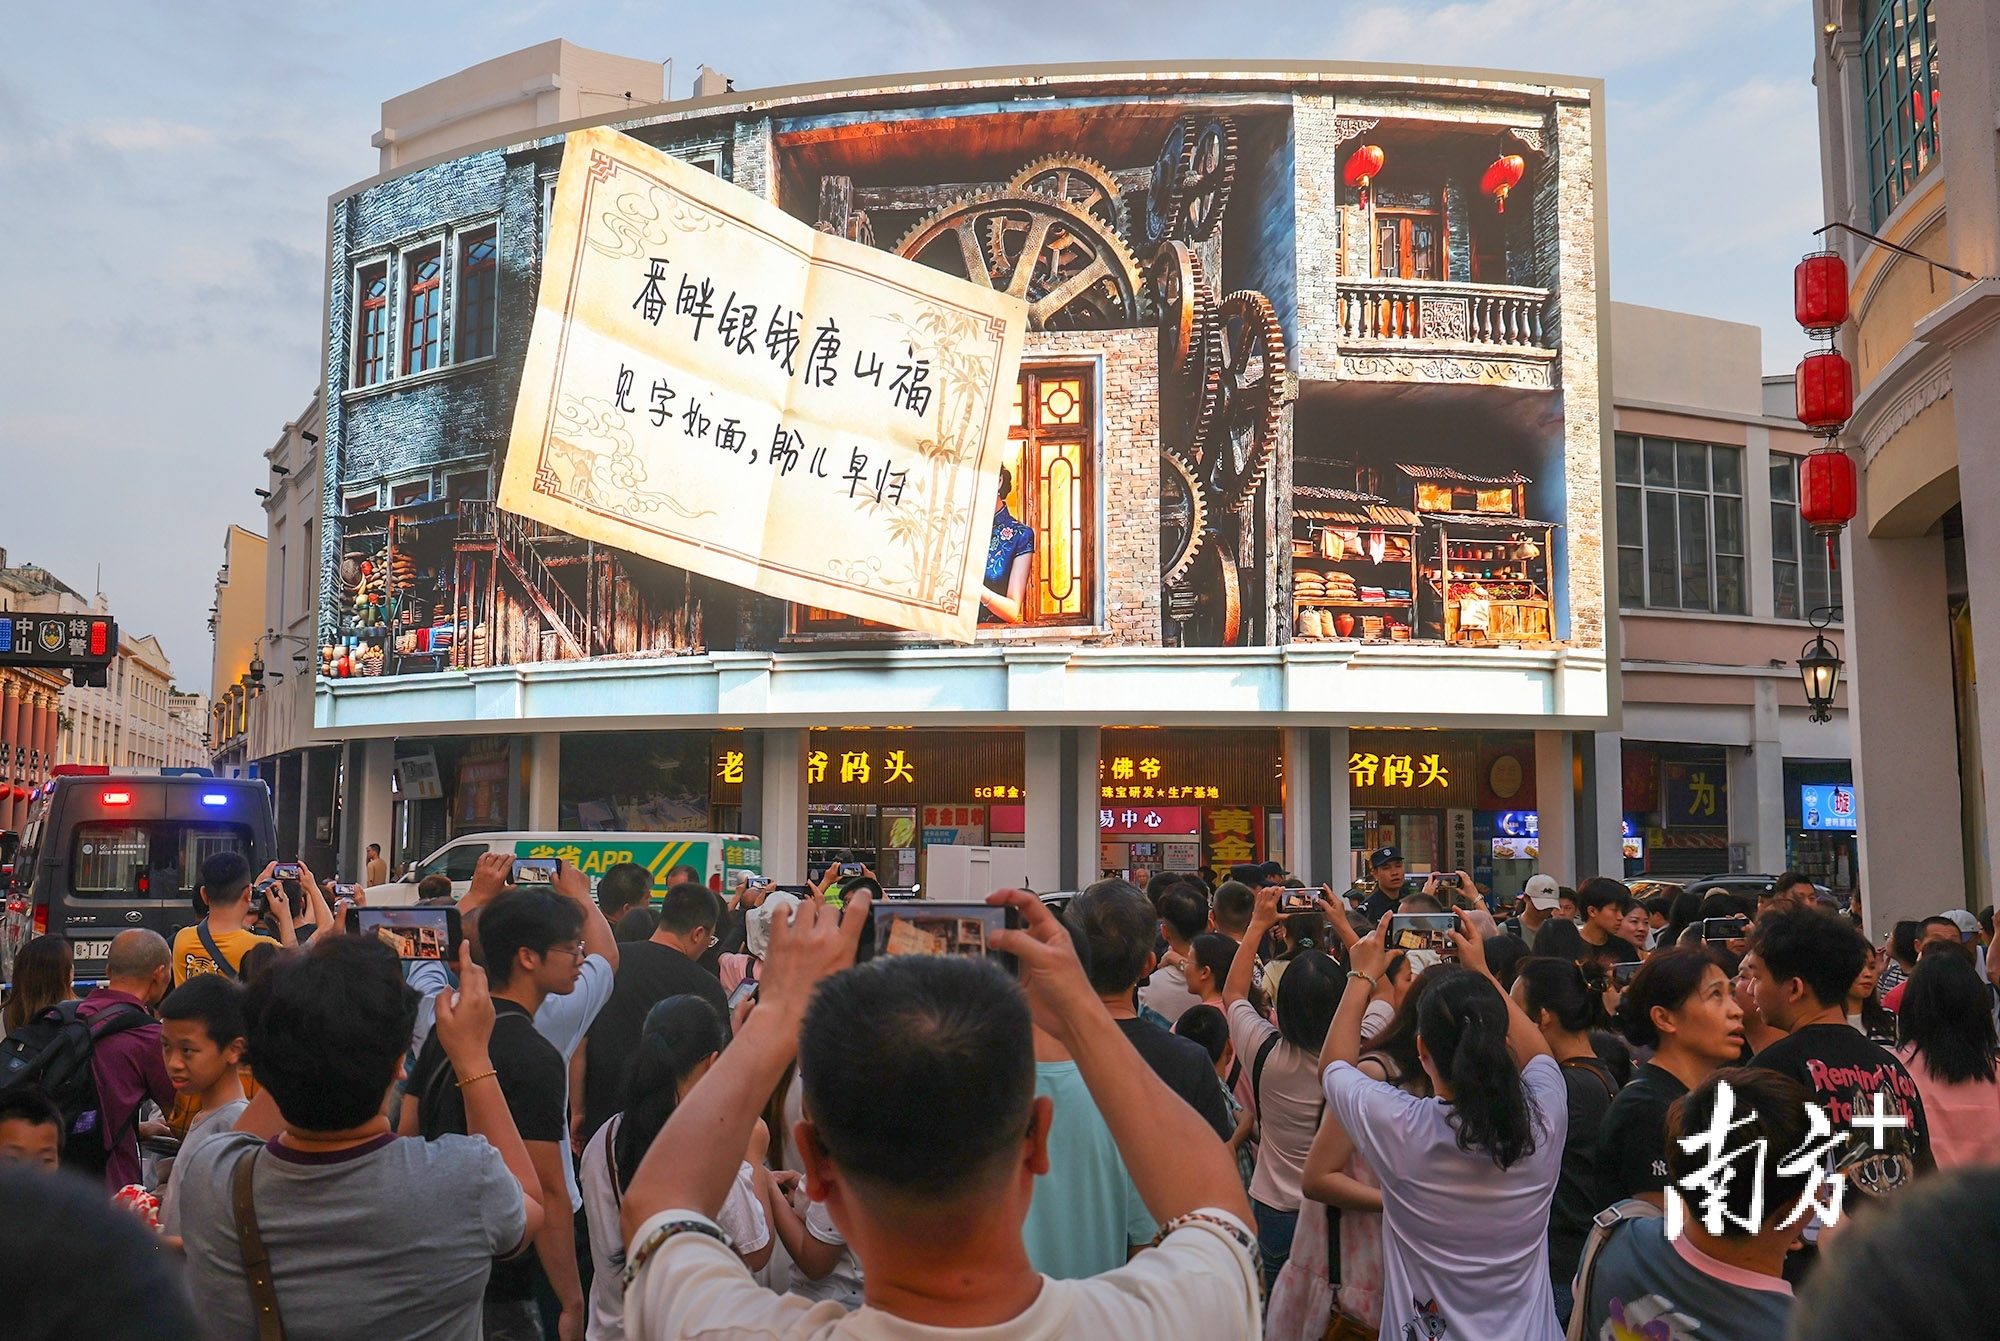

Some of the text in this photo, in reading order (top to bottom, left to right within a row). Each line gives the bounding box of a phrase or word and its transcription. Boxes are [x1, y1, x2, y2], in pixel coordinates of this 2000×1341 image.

[15, 617, 34, 655] 中山
[68, 619, 88, 656] 特警
[1806, 1059, 1916, 1101] Remind You
[1822, 1096, 1852, 1124] to
